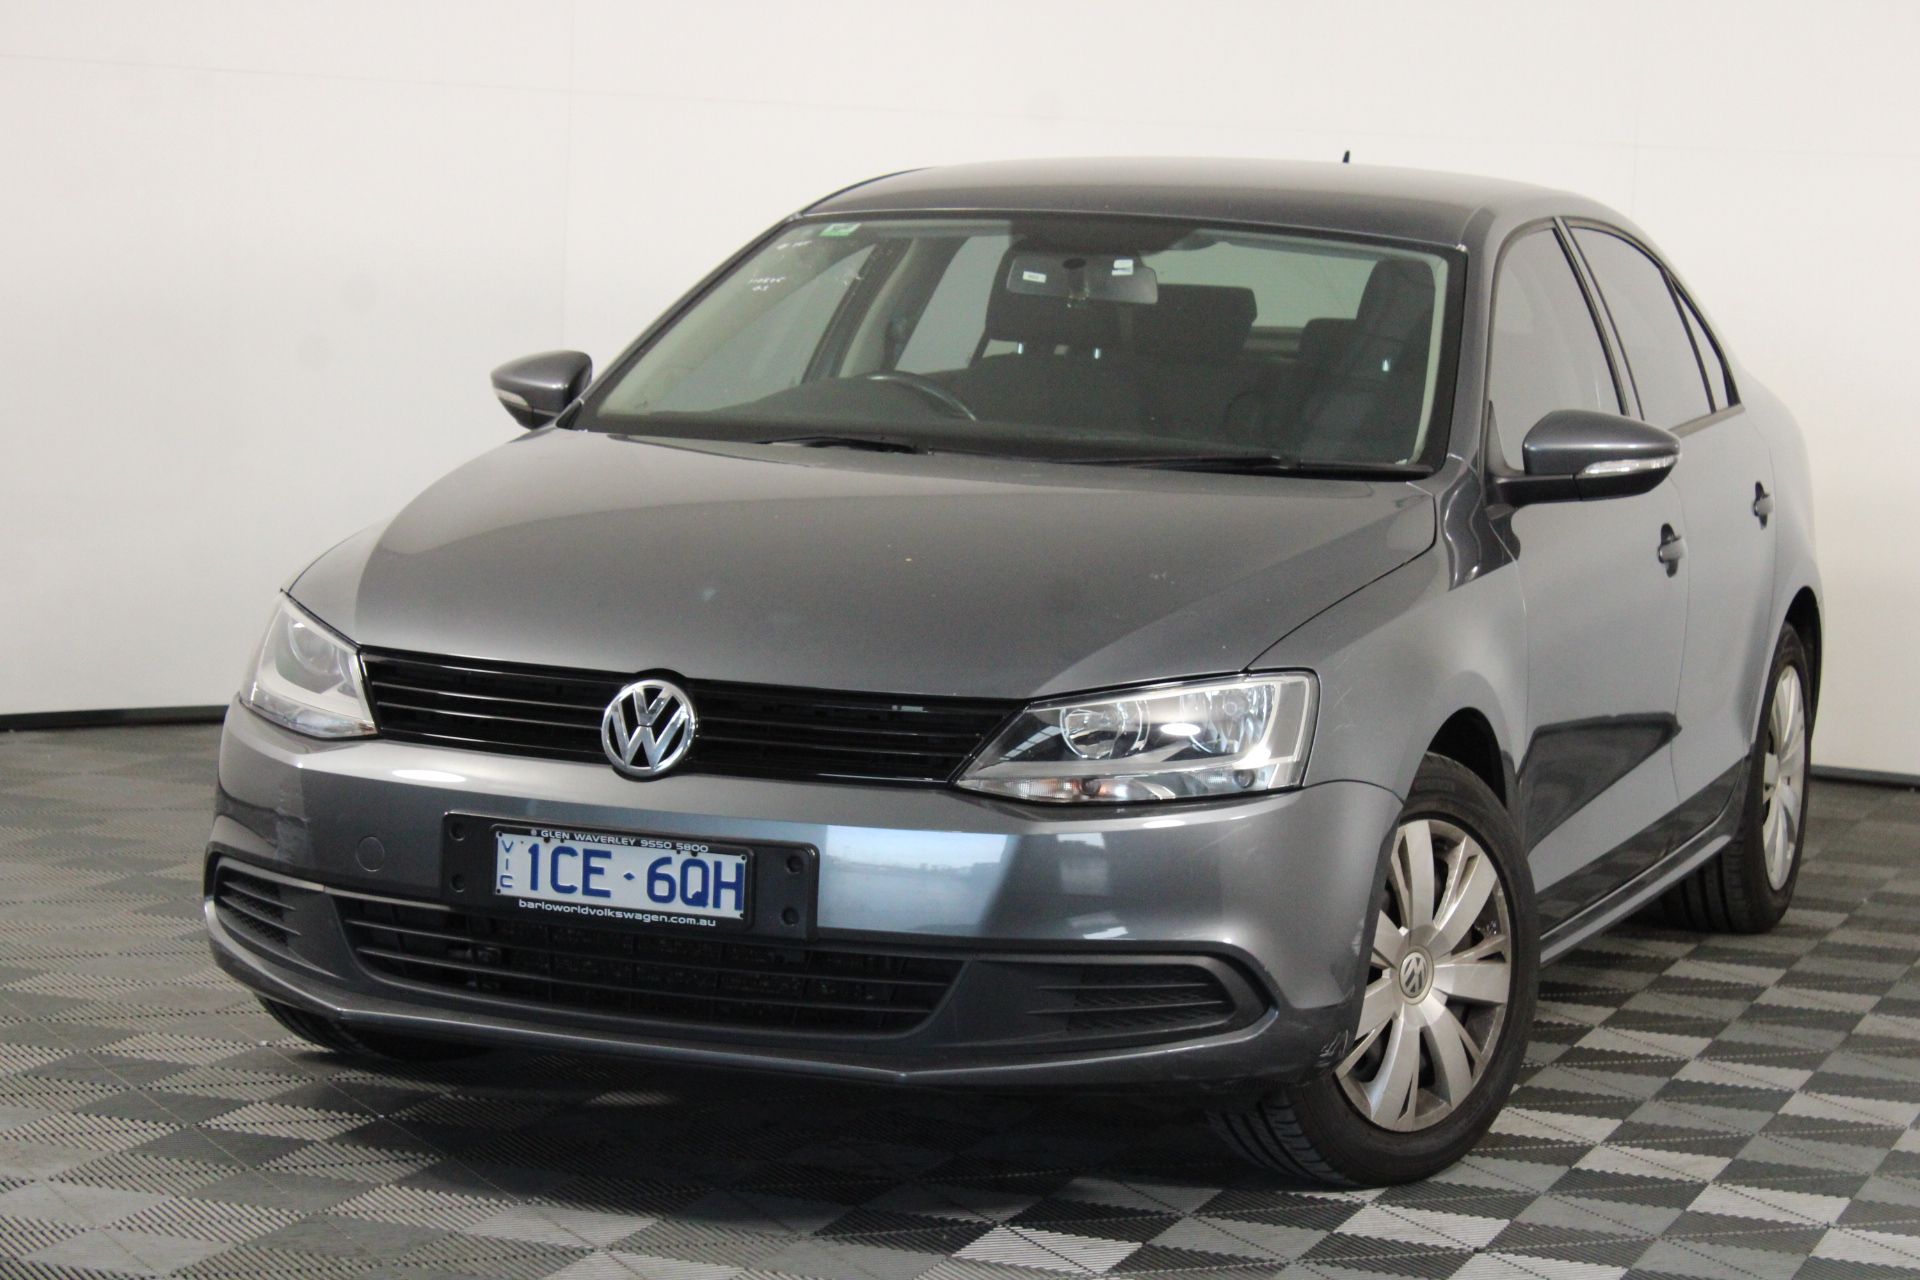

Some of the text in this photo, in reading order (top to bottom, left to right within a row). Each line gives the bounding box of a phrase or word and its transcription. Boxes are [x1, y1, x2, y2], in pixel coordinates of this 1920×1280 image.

[541, 830, 709, 853] GLEN WAVERLEY 9550 5800
[500, 840, 515, 889] VIC
[518, 899, 716, 927] barloworldvolkswagen.com.au
